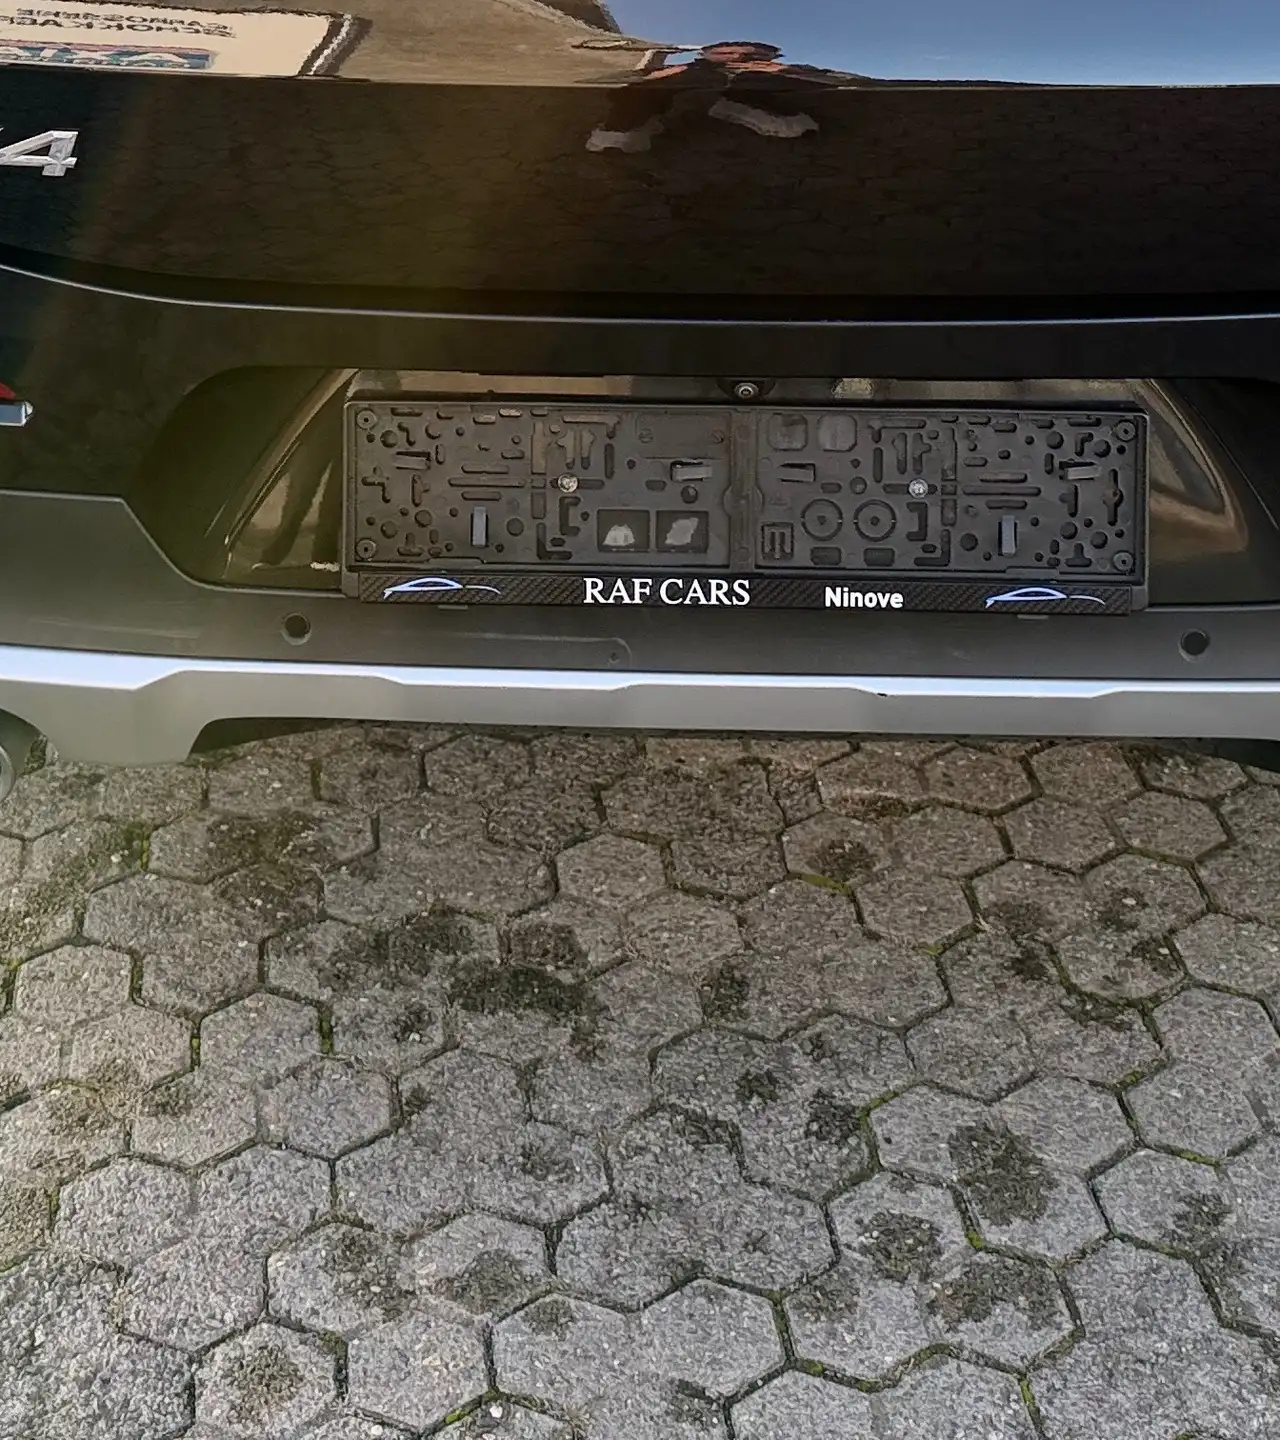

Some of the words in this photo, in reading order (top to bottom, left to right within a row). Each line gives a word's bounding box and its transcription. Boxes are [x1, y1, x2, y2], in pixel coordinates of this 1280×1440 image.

[583, 577, 652, 604] RAF
[659, 578, 751, 607] CARS
[825, 586, 904, 609] Ninove
